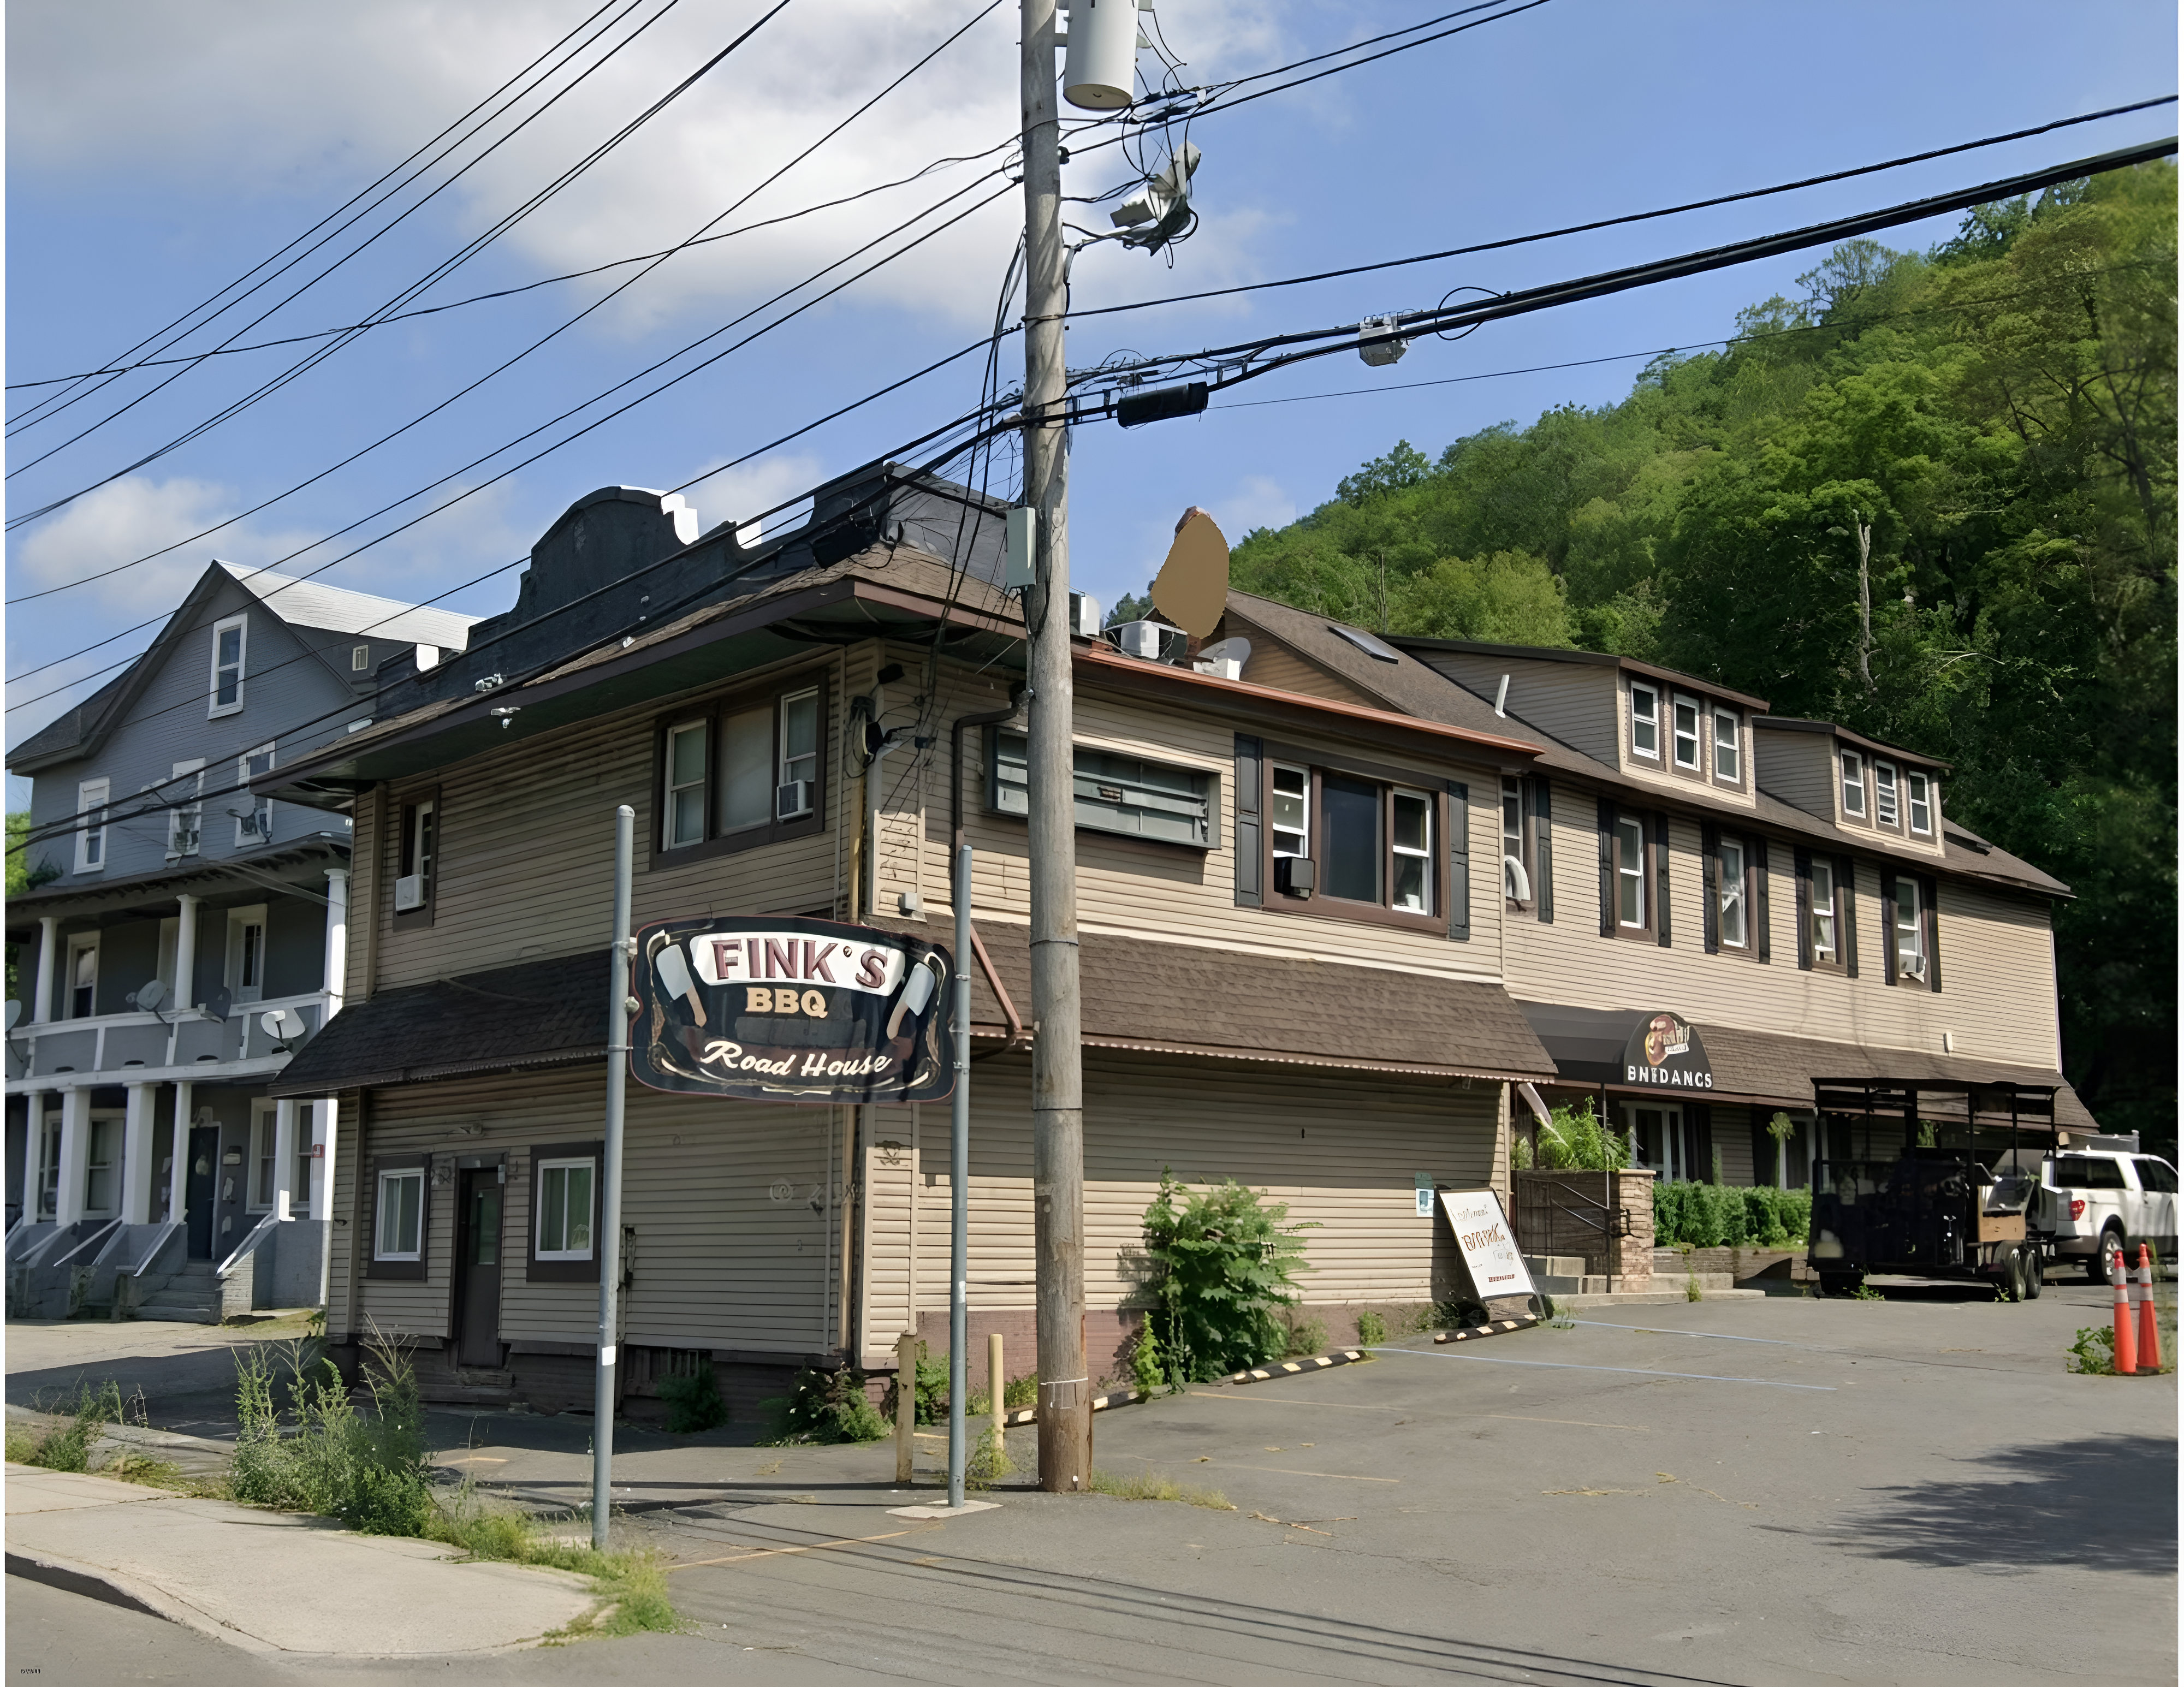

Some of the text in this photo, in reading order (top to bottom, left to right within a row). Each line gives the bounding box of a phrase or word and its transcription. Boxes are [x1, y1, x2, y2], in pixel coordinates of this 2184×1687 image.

[711, 938, 887, 988] FINK'S
[745, 988, 828, 1018] BBQ
[700, 1041, 892, 1077] Road House
